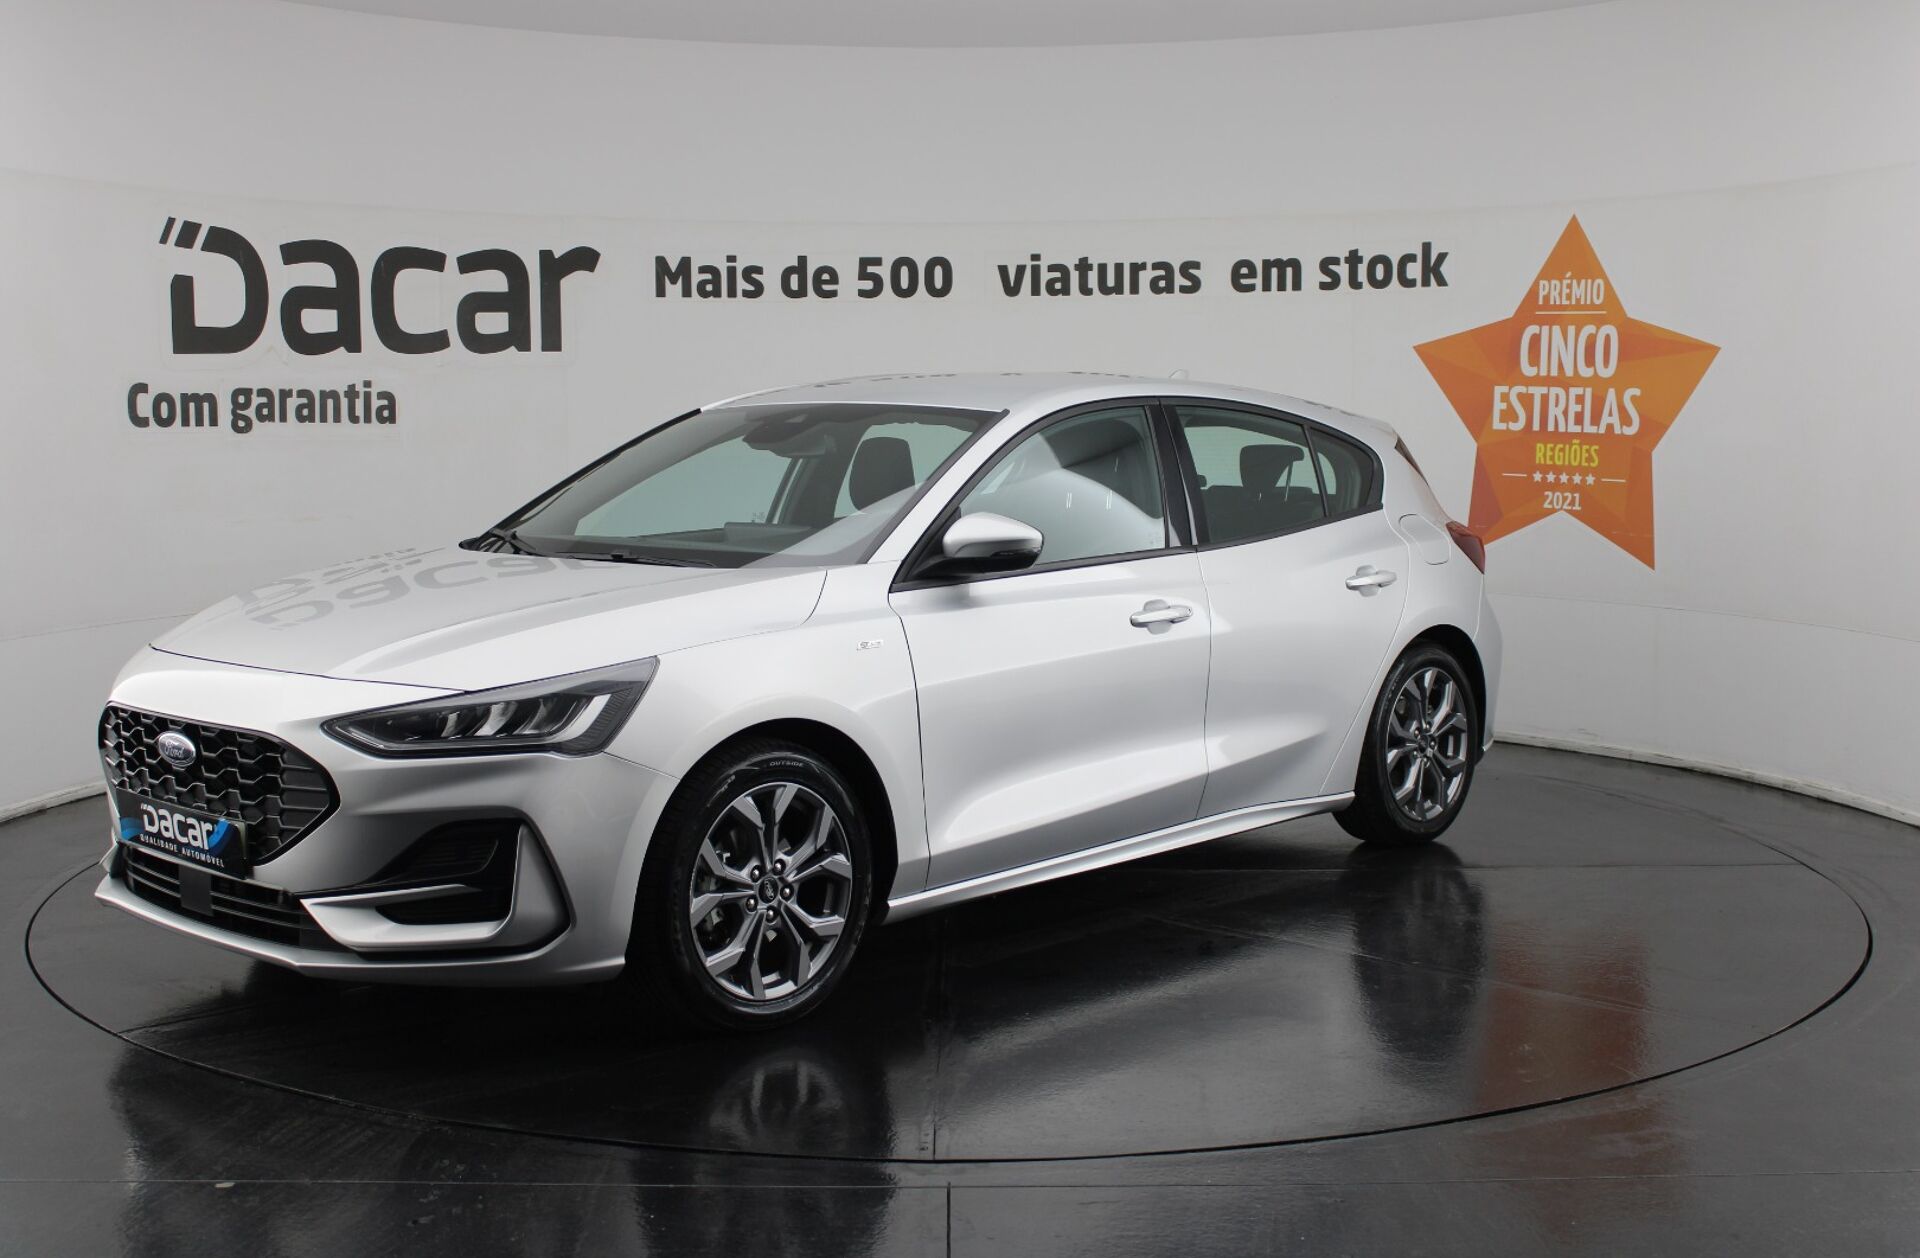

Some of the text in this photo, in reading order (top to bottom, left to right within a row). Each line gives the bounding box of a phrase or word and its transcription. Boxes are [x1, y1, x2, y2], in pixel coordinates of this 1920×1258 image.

[159, 216, 600, 355] Dacar
[655, 242, 1449, 299] Mais de 500 viaturas em stock
[1538, 272, 1604, 305] PRÉMIO
[1520, 324, 1619, 378] CINCO
[128, 380, 397, 433] Com garantia
[1492, 386, 1641, 435] ESTRELAS
[1536, 439, 1599, 467] REGIÕES
[1543, 491, 1581, 510] 2021
[141, 803, 212, 850] Dacar
